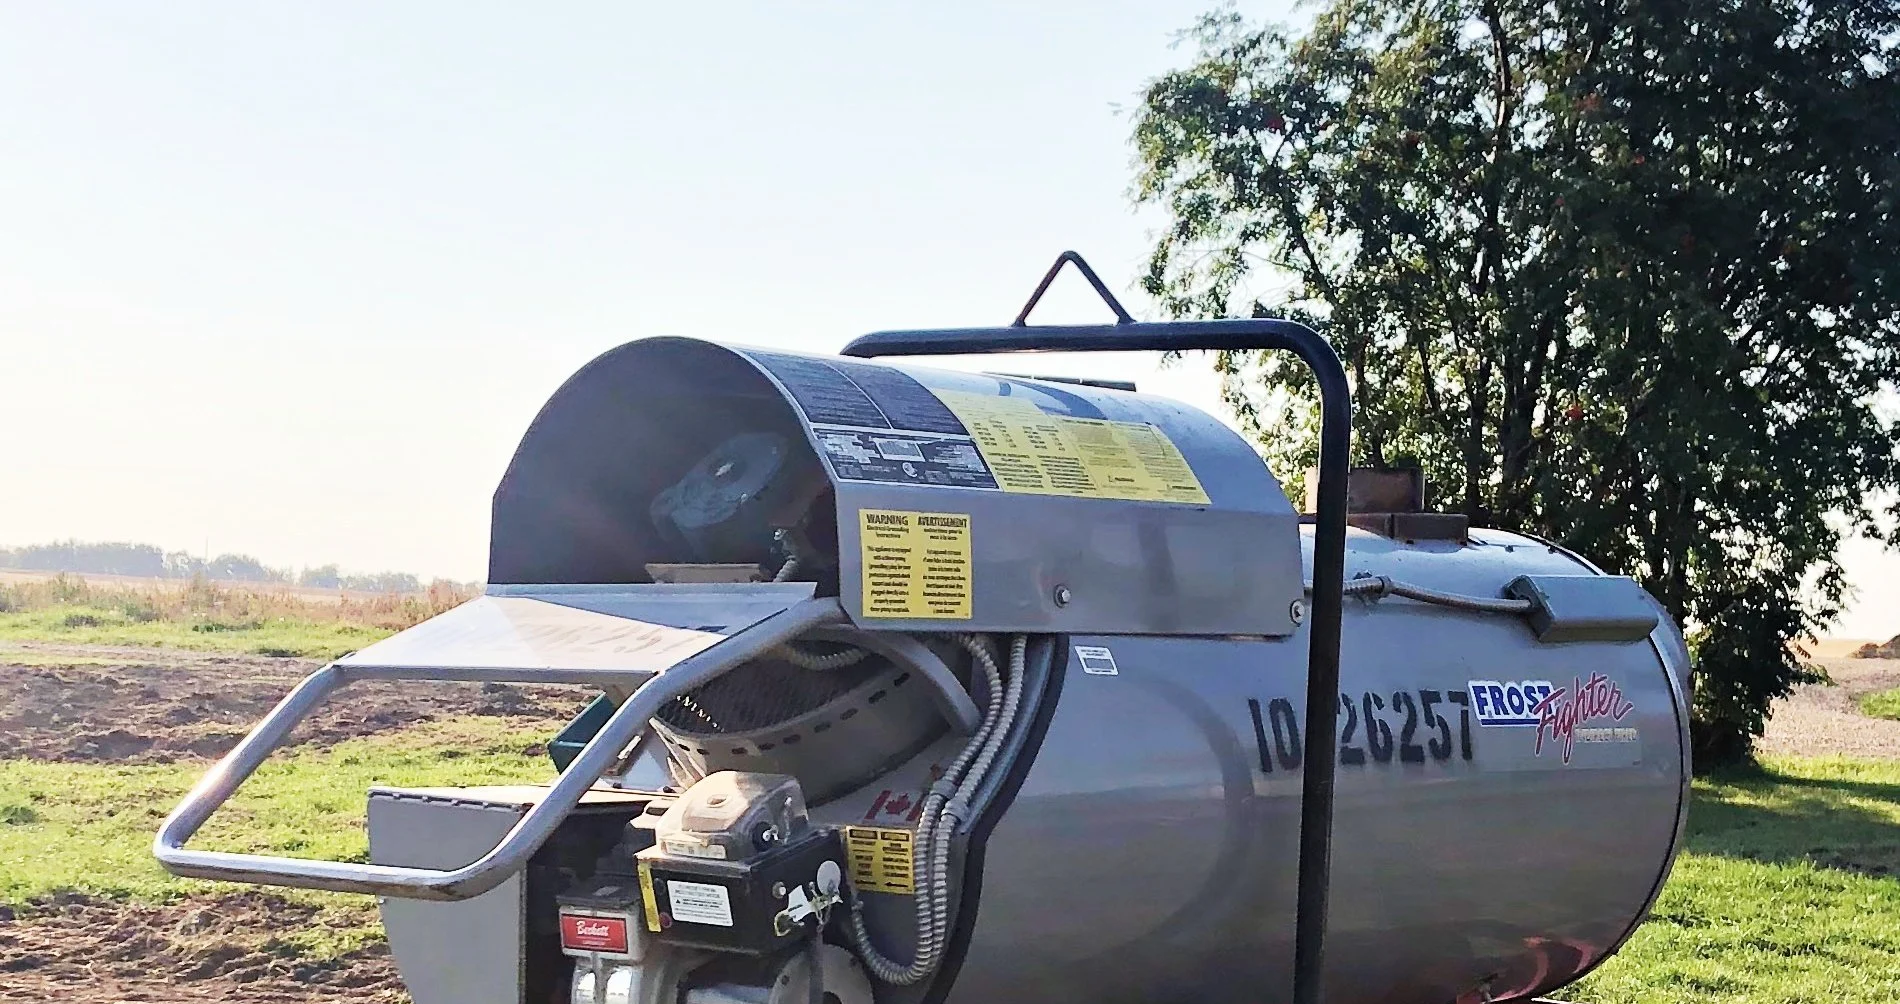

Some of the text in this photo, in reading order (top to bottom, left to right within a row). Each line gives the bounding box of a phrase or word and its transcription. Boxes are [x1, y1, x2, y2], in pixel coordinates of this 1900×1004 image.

[866, 513, 909, 526] WARNING
[1472, 671, 1634, 764] FROST Fighter
